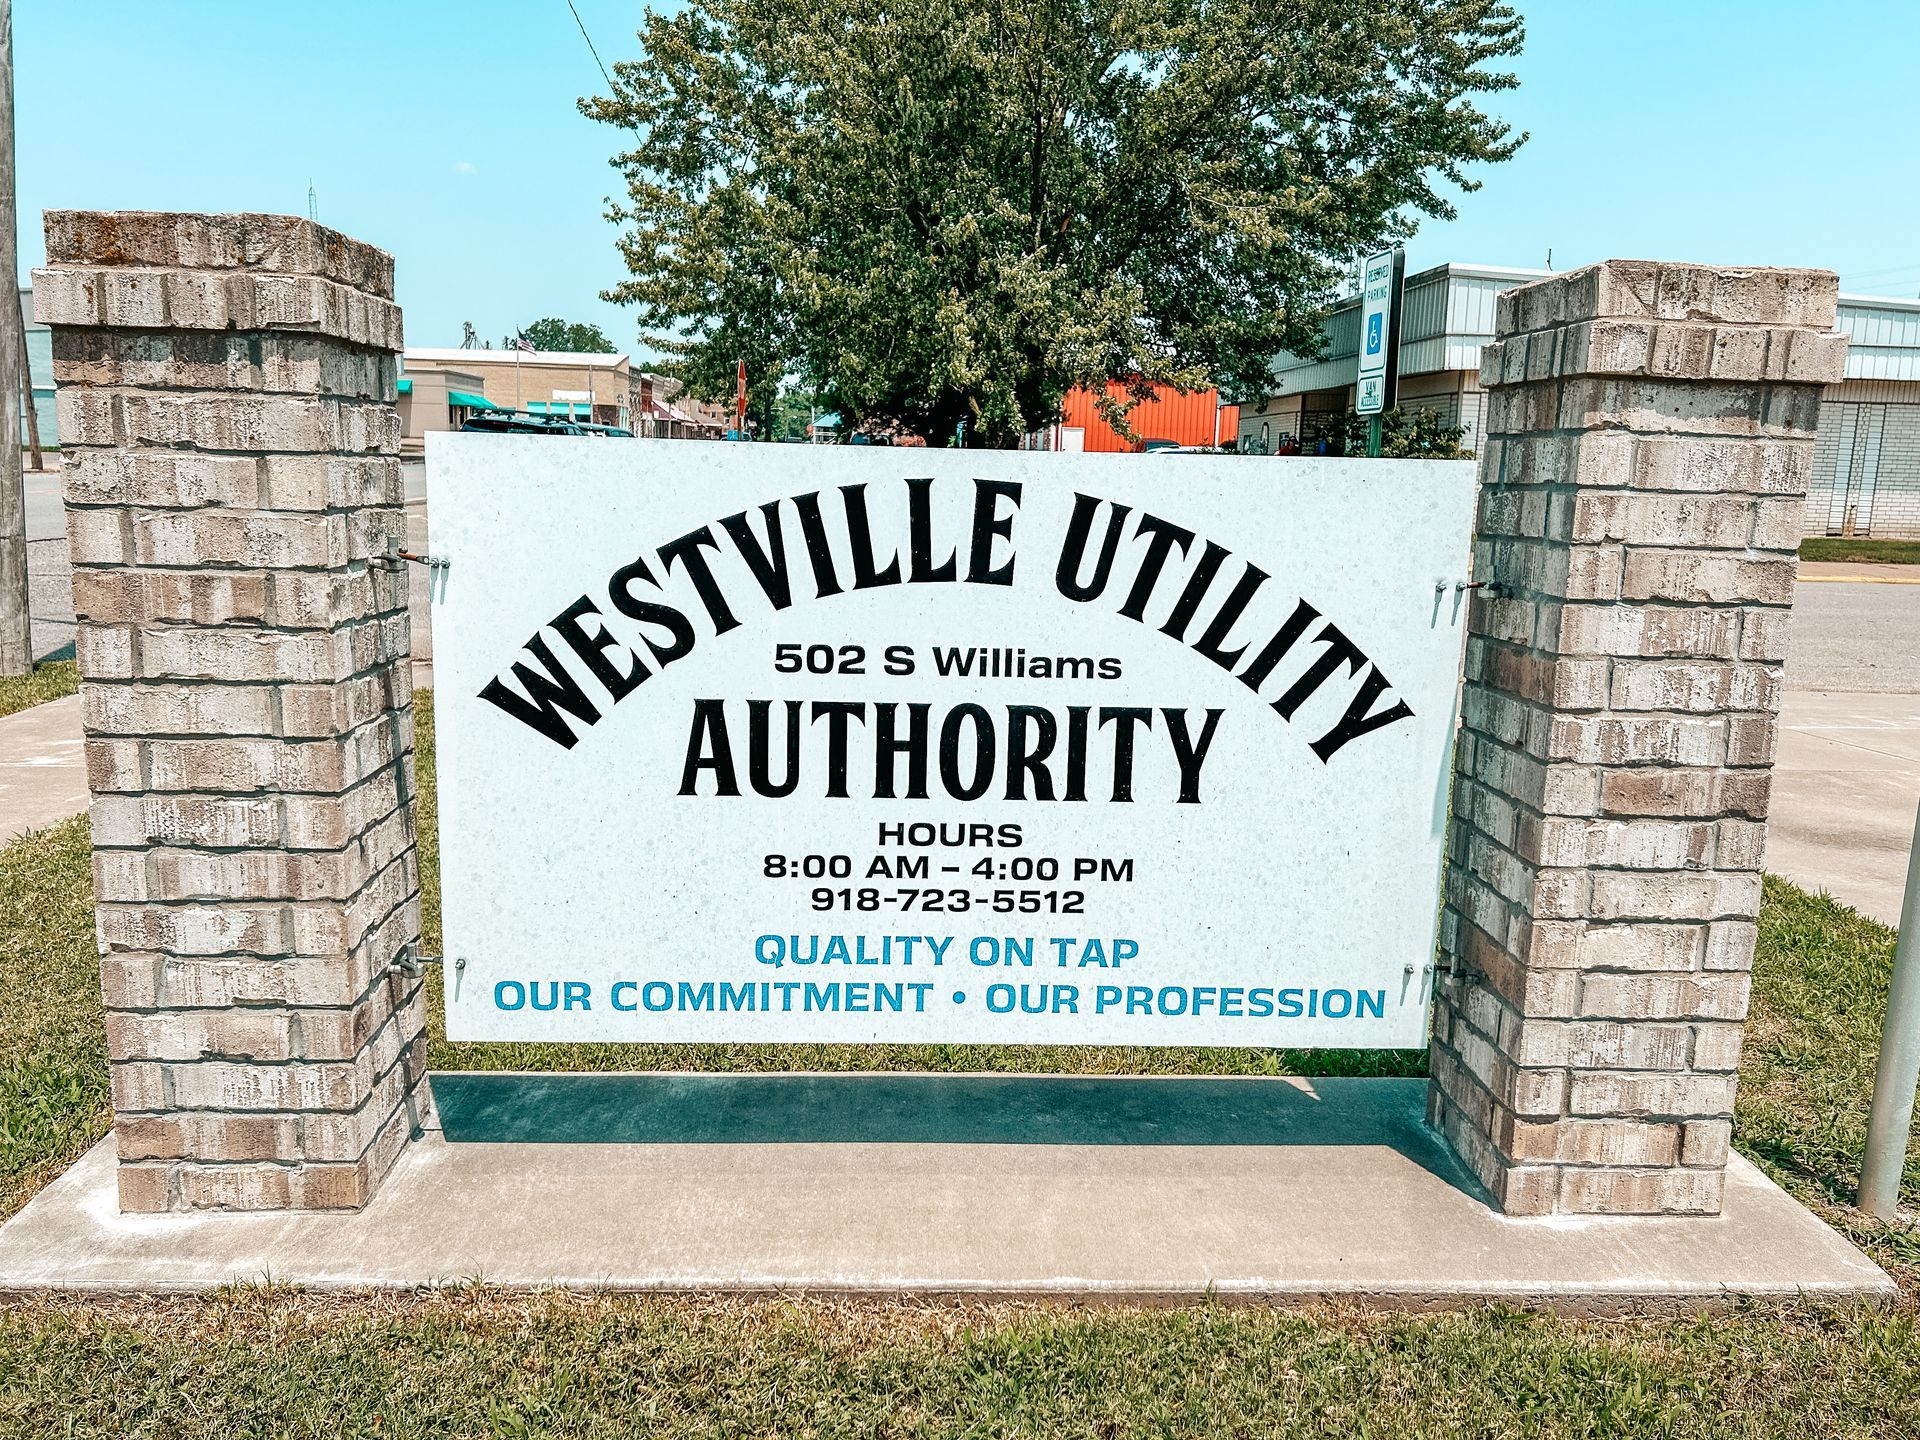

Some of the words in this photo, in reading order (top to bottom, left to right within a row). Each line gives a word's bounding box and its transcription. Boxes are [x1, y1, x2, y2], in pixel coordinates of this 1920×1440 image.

[1367, 286, 1387, 303] PARKING
[1365, 380, 1376, 394] VAN
[477, 478, 1022, 750] WESTVILLE
[1056, 492, 1415, 765] UTILITY
[775, 644, 865, 674] 502
[884, 646, 915, 675] S
[932, 647, 1121, 679] Williams
[677, 699, 1225, 803] AUTHORITY
[879, 823, 1022, 847] HOURS
[764, 855, 851, 878] 8:00
[866, 856, 928, 878] AM
[972, 858, 1058, 880] 4:00
[1074, 858, 1133, 881] PM
[812, 888, 1084, 913] 918-723-5512
[755, 935, 954, 968] QUALITY
[970, 937, 1033, 966] ON
[1050, 938, 1138, 967] TAP
[494, 981, 591, 1011] OUR
[611, 982, 933, 1012] COMMITMENT
[986, 984, 1079, 1013] OUR
[1096, 986, 1385, 1018] PROFESSION
